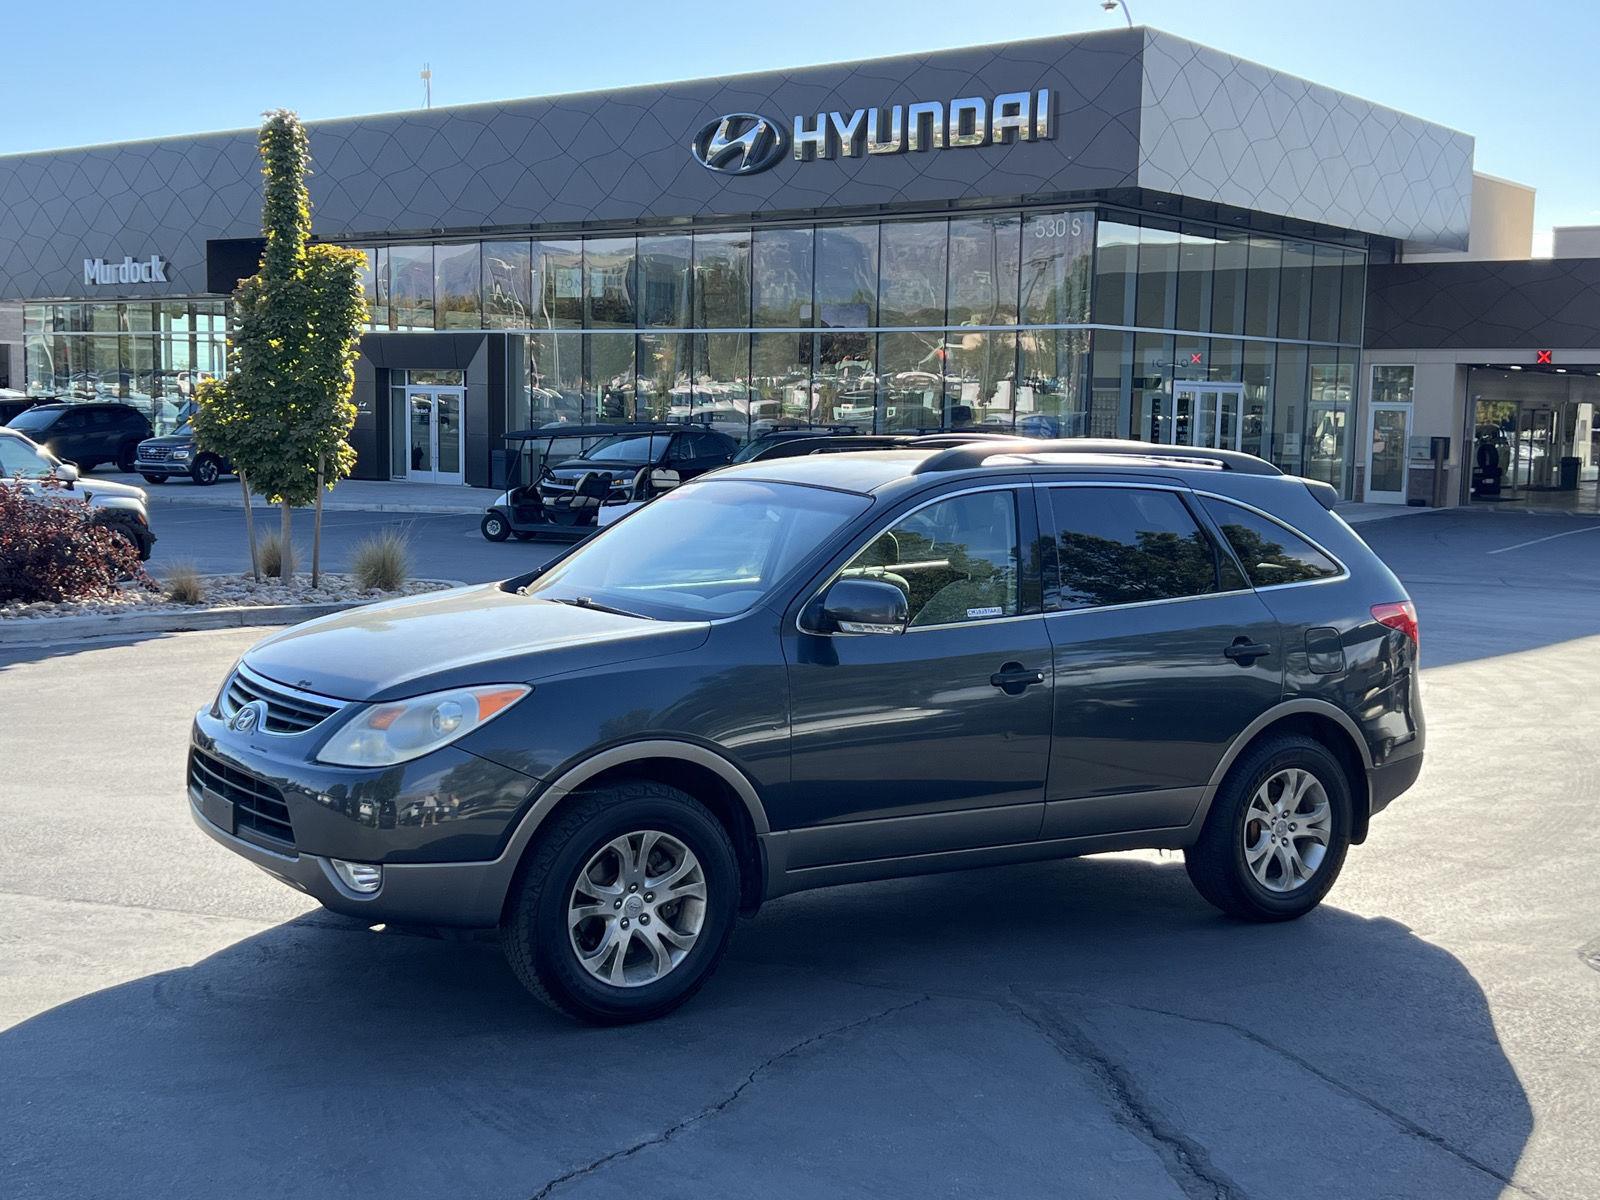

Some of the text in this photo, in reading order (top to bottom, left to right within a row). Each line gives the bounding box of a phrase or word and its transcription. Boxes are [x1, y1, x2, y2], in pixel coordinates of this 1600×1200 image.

[793, 88, 1051, 161] HYUNDAI
[1035, 217, 1081, 238] 530 S
[83, 254, 168, 285] Murdock
